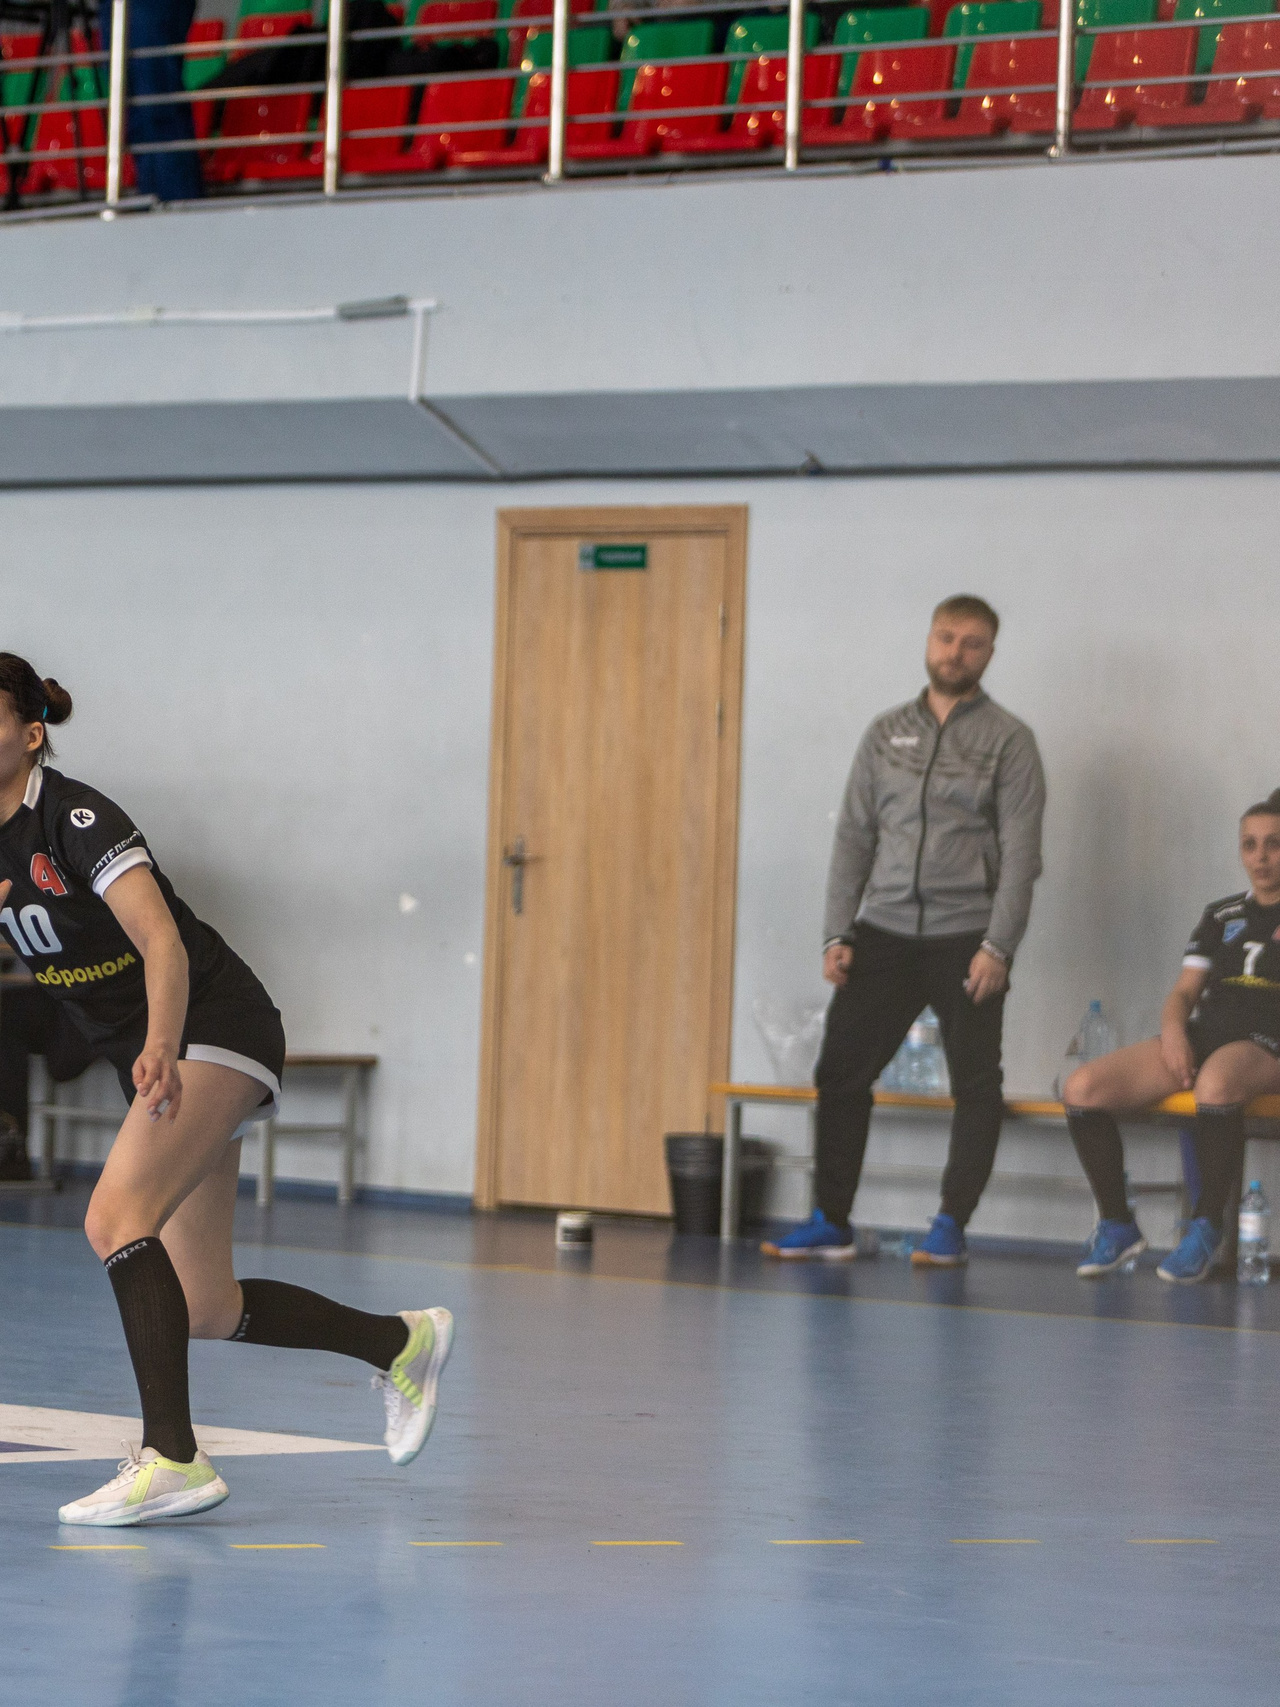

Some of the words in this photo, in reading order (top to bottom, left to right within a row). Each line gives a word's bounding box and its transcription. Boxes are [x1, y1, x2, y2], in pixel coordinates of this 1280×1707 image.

[35, 952, 136, 988] оброном
[1243, 941, 1266, 977] 7
[105, 1240, 147, 1271] mpa
